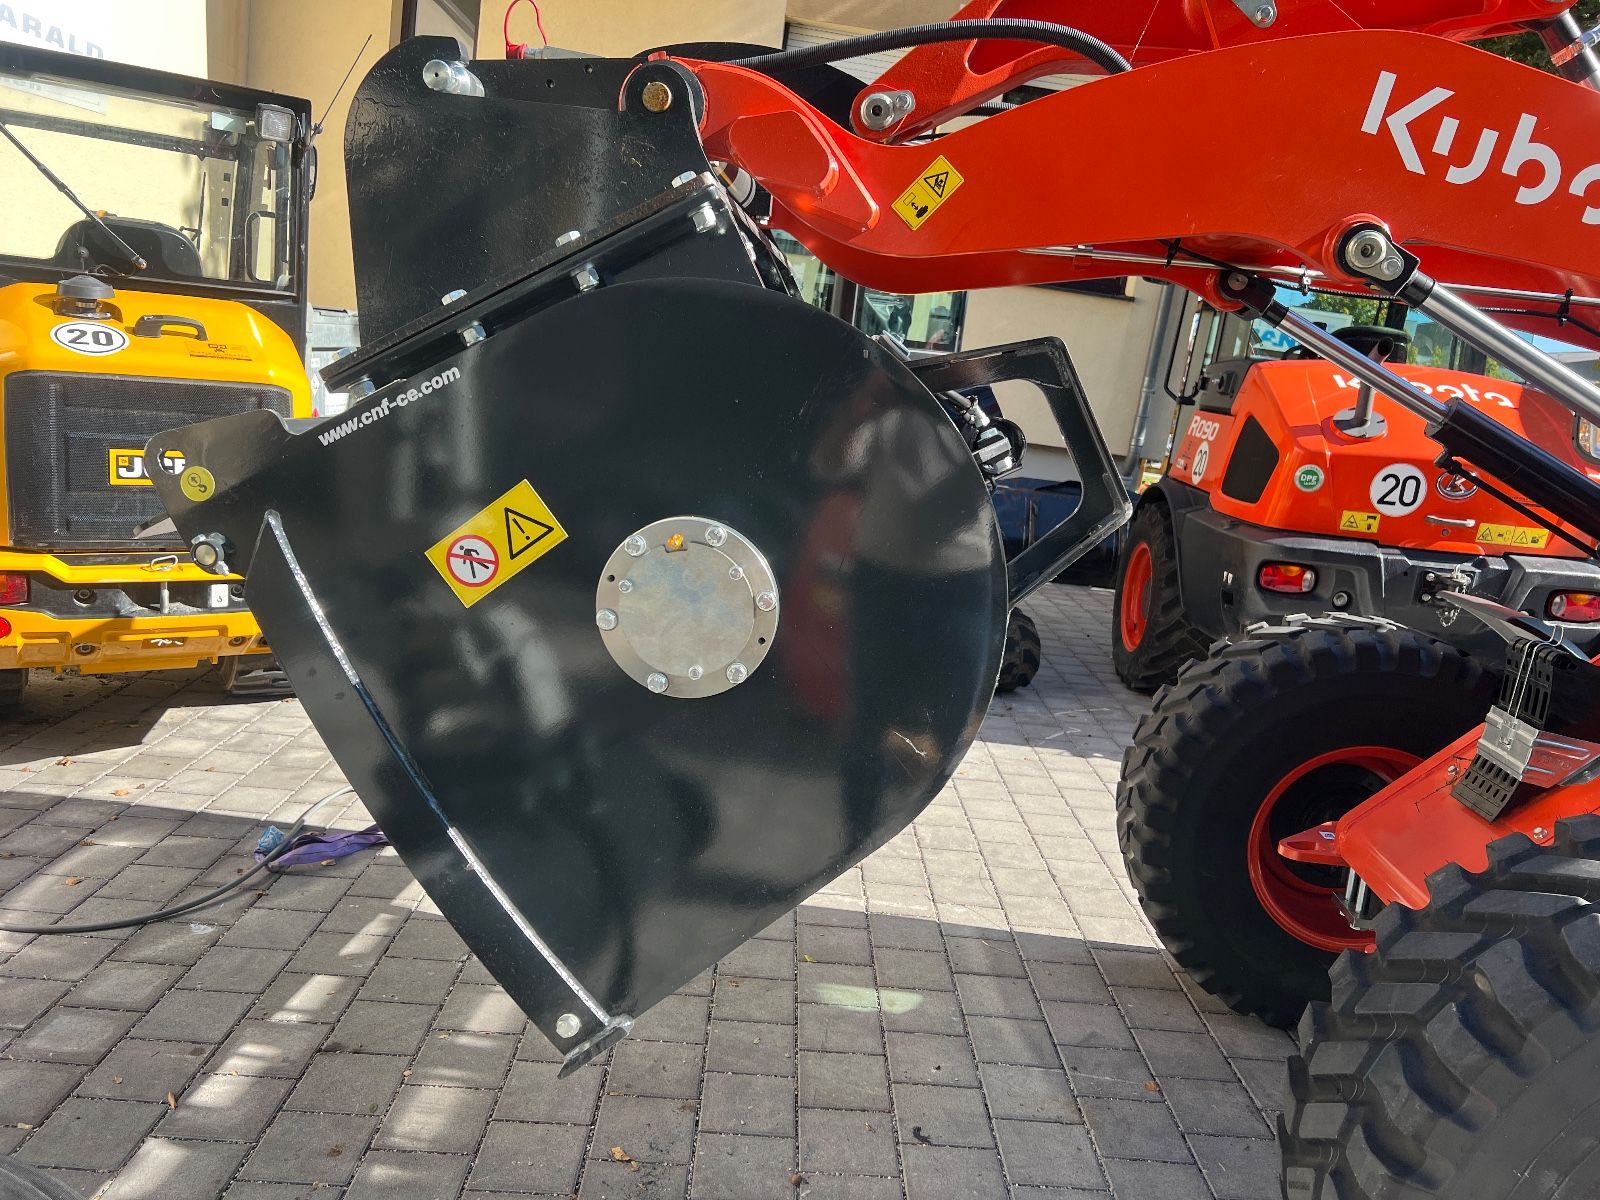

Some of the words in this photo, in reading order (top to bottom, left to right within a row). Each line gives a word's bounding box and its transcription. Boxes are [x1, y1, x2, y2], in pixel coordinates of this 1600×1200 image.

[66, 328, 114, 347] 20
[318, 366, 461, 447] www.cnf-ce.com
[1193, 449, 1208, 477] 20
[1376, 473, 1421, 507] 20
